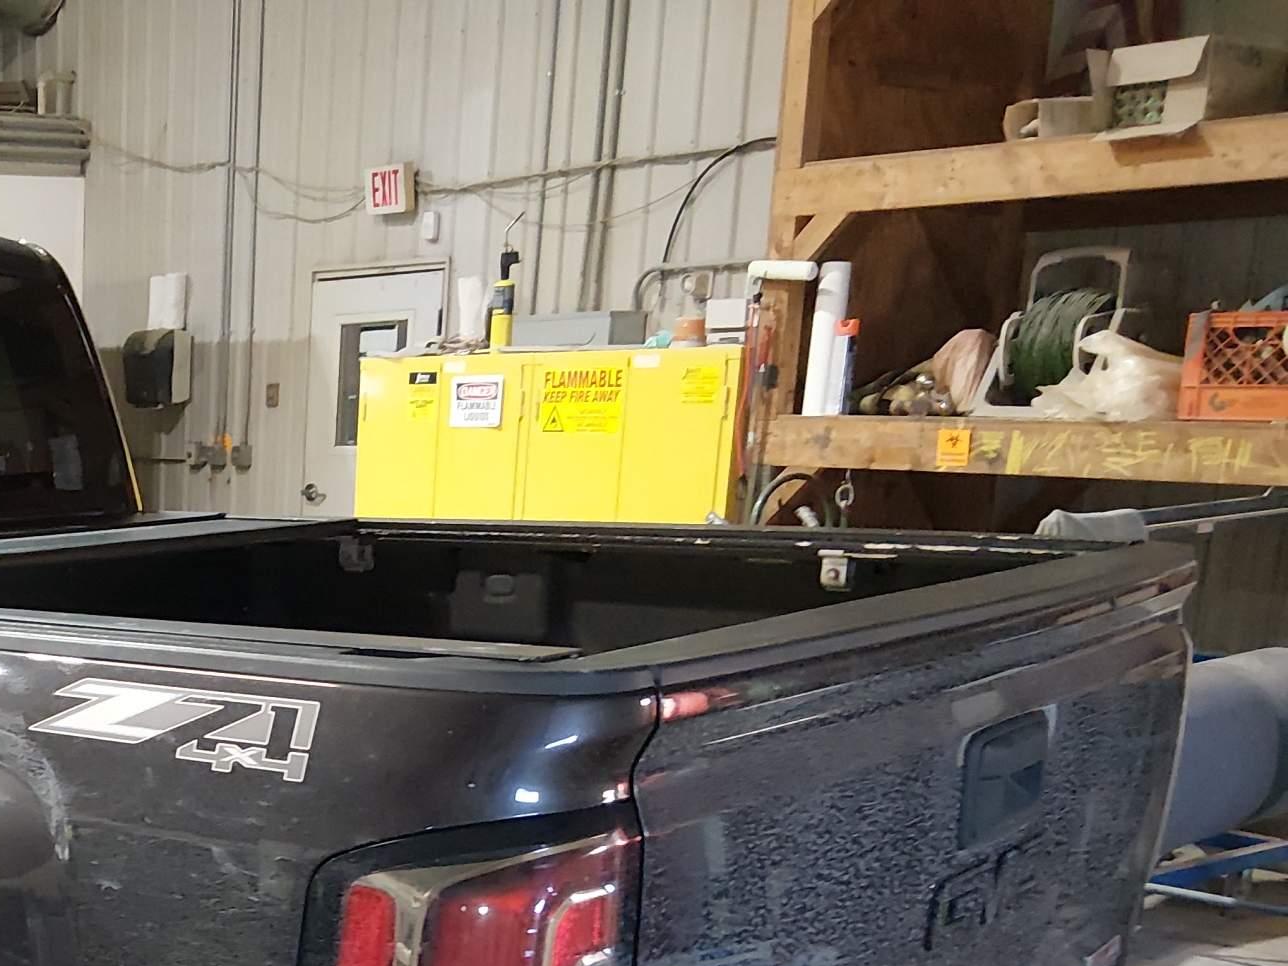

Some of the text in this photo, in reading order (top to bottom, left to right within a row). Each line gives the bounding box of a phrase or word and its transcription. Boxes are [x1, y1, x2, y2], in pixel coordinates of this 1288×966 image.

[371, 169, 399, 208] EXIT
[544, 369, 623, 389] FLAMMABLE
[543, 390, 621, 403] KEEP FIRE AWAY
[28, 677, 321, 751] Z71
